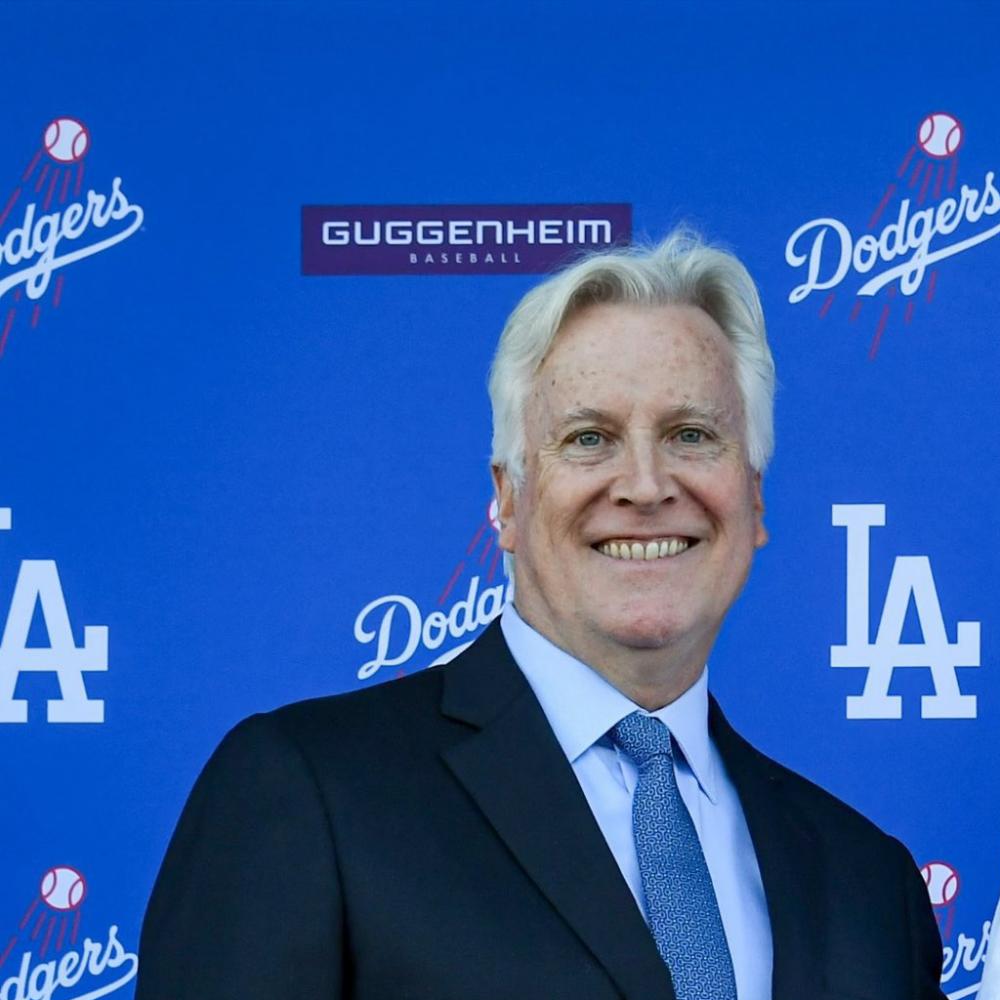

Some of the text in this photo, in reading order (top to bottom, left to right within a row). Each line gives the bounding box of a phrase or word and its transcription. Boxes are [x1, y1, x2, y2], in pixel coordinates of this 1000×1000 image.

[0, 177, 144, 300] dgers
[322, 219, 611, 245] GUGGENHEIM
[410, 253, 521, 264] BASEBALL
[830, 504, 981, 719] LA
